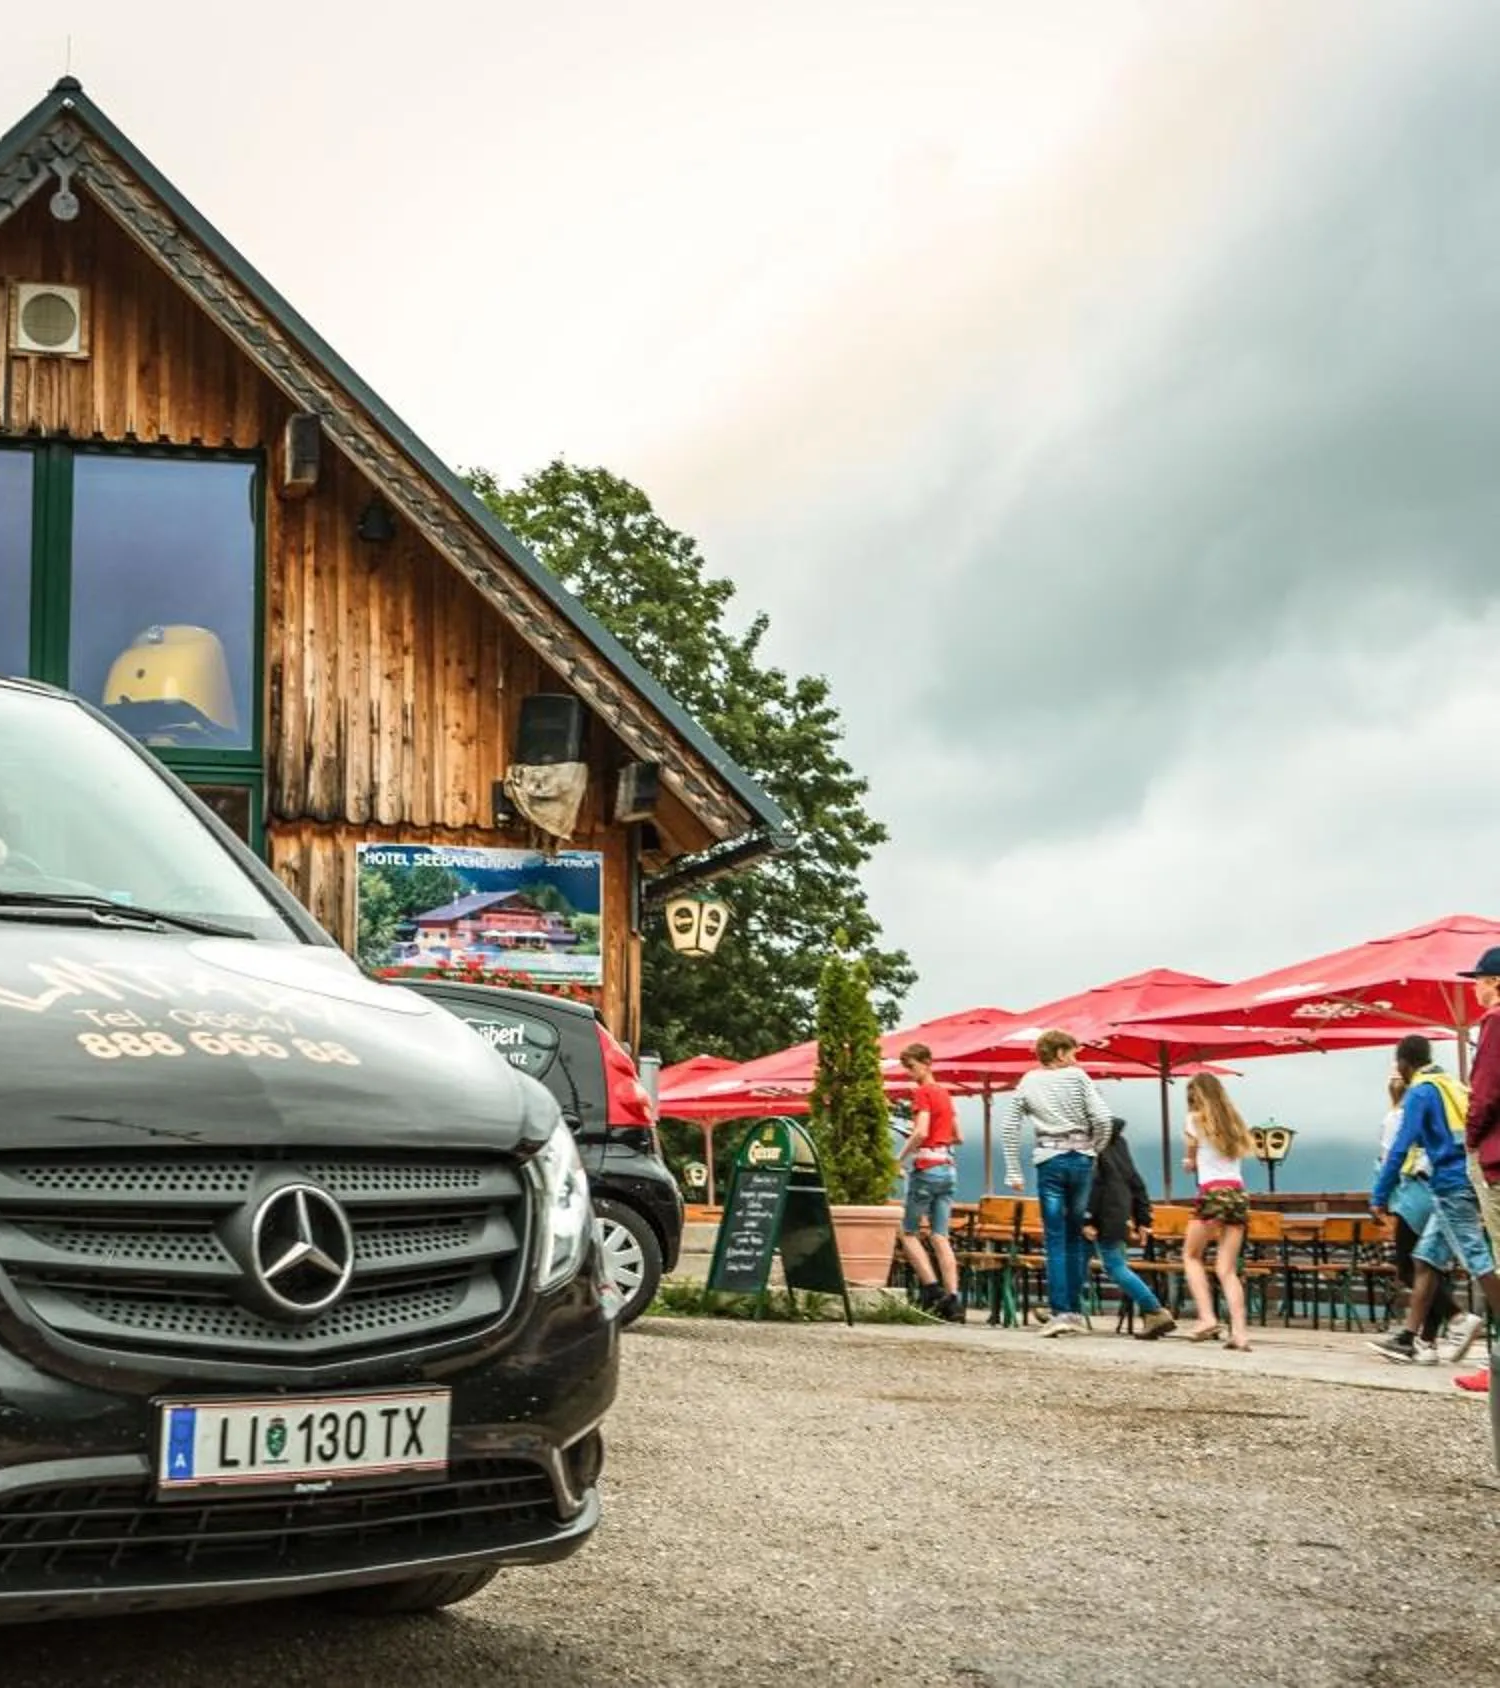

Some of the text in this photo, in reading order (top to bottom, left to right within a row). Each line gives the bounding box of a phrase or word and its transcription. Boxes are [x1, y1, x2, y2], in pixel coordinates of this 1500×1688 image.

[364, 851, 410, 867] HOTEL
[73, 1008, 162, 1028] Tel.
[77, 1031, 361, 1066] 888 666 88
[218, 1405, 427, 1468] LI 130 TX
[174, 1453, 187, 1468] A
